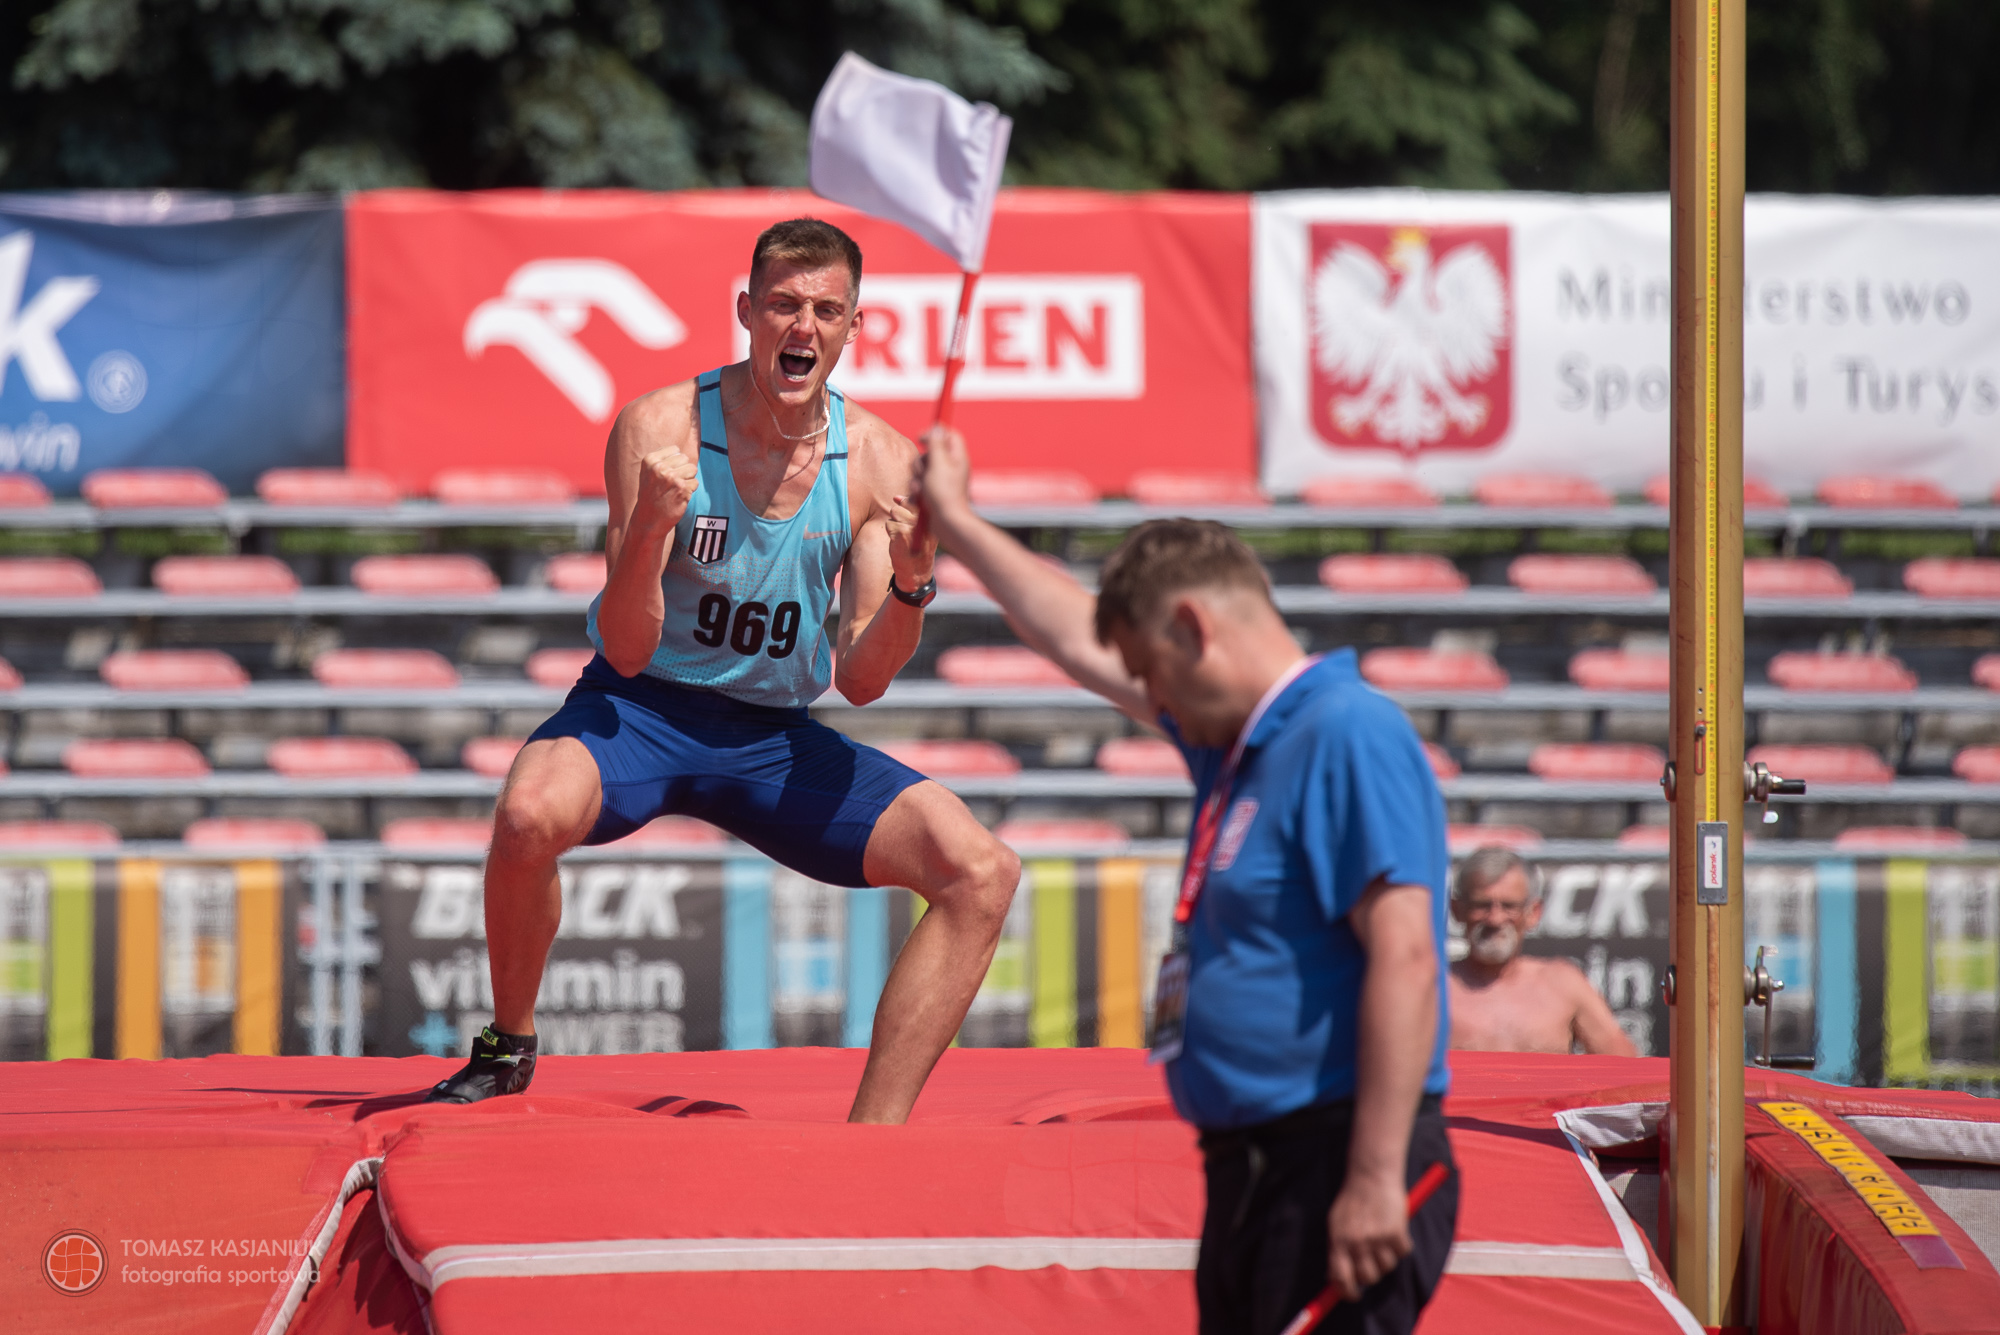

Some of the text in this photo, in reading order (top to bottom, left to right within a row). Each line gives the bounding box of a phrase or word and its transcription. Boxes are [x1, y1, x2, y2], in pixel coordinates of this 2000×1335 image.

[1556, 264, 1971, 326] Minerstwo
[851, 300, 1110, 373] RLEN
[1556, 350, 1766, 422] Spou
[1792, 351, 1808, 413] i
[693, 593, 802, 660] 969
[1709, 853, 1719, 885] polanik
